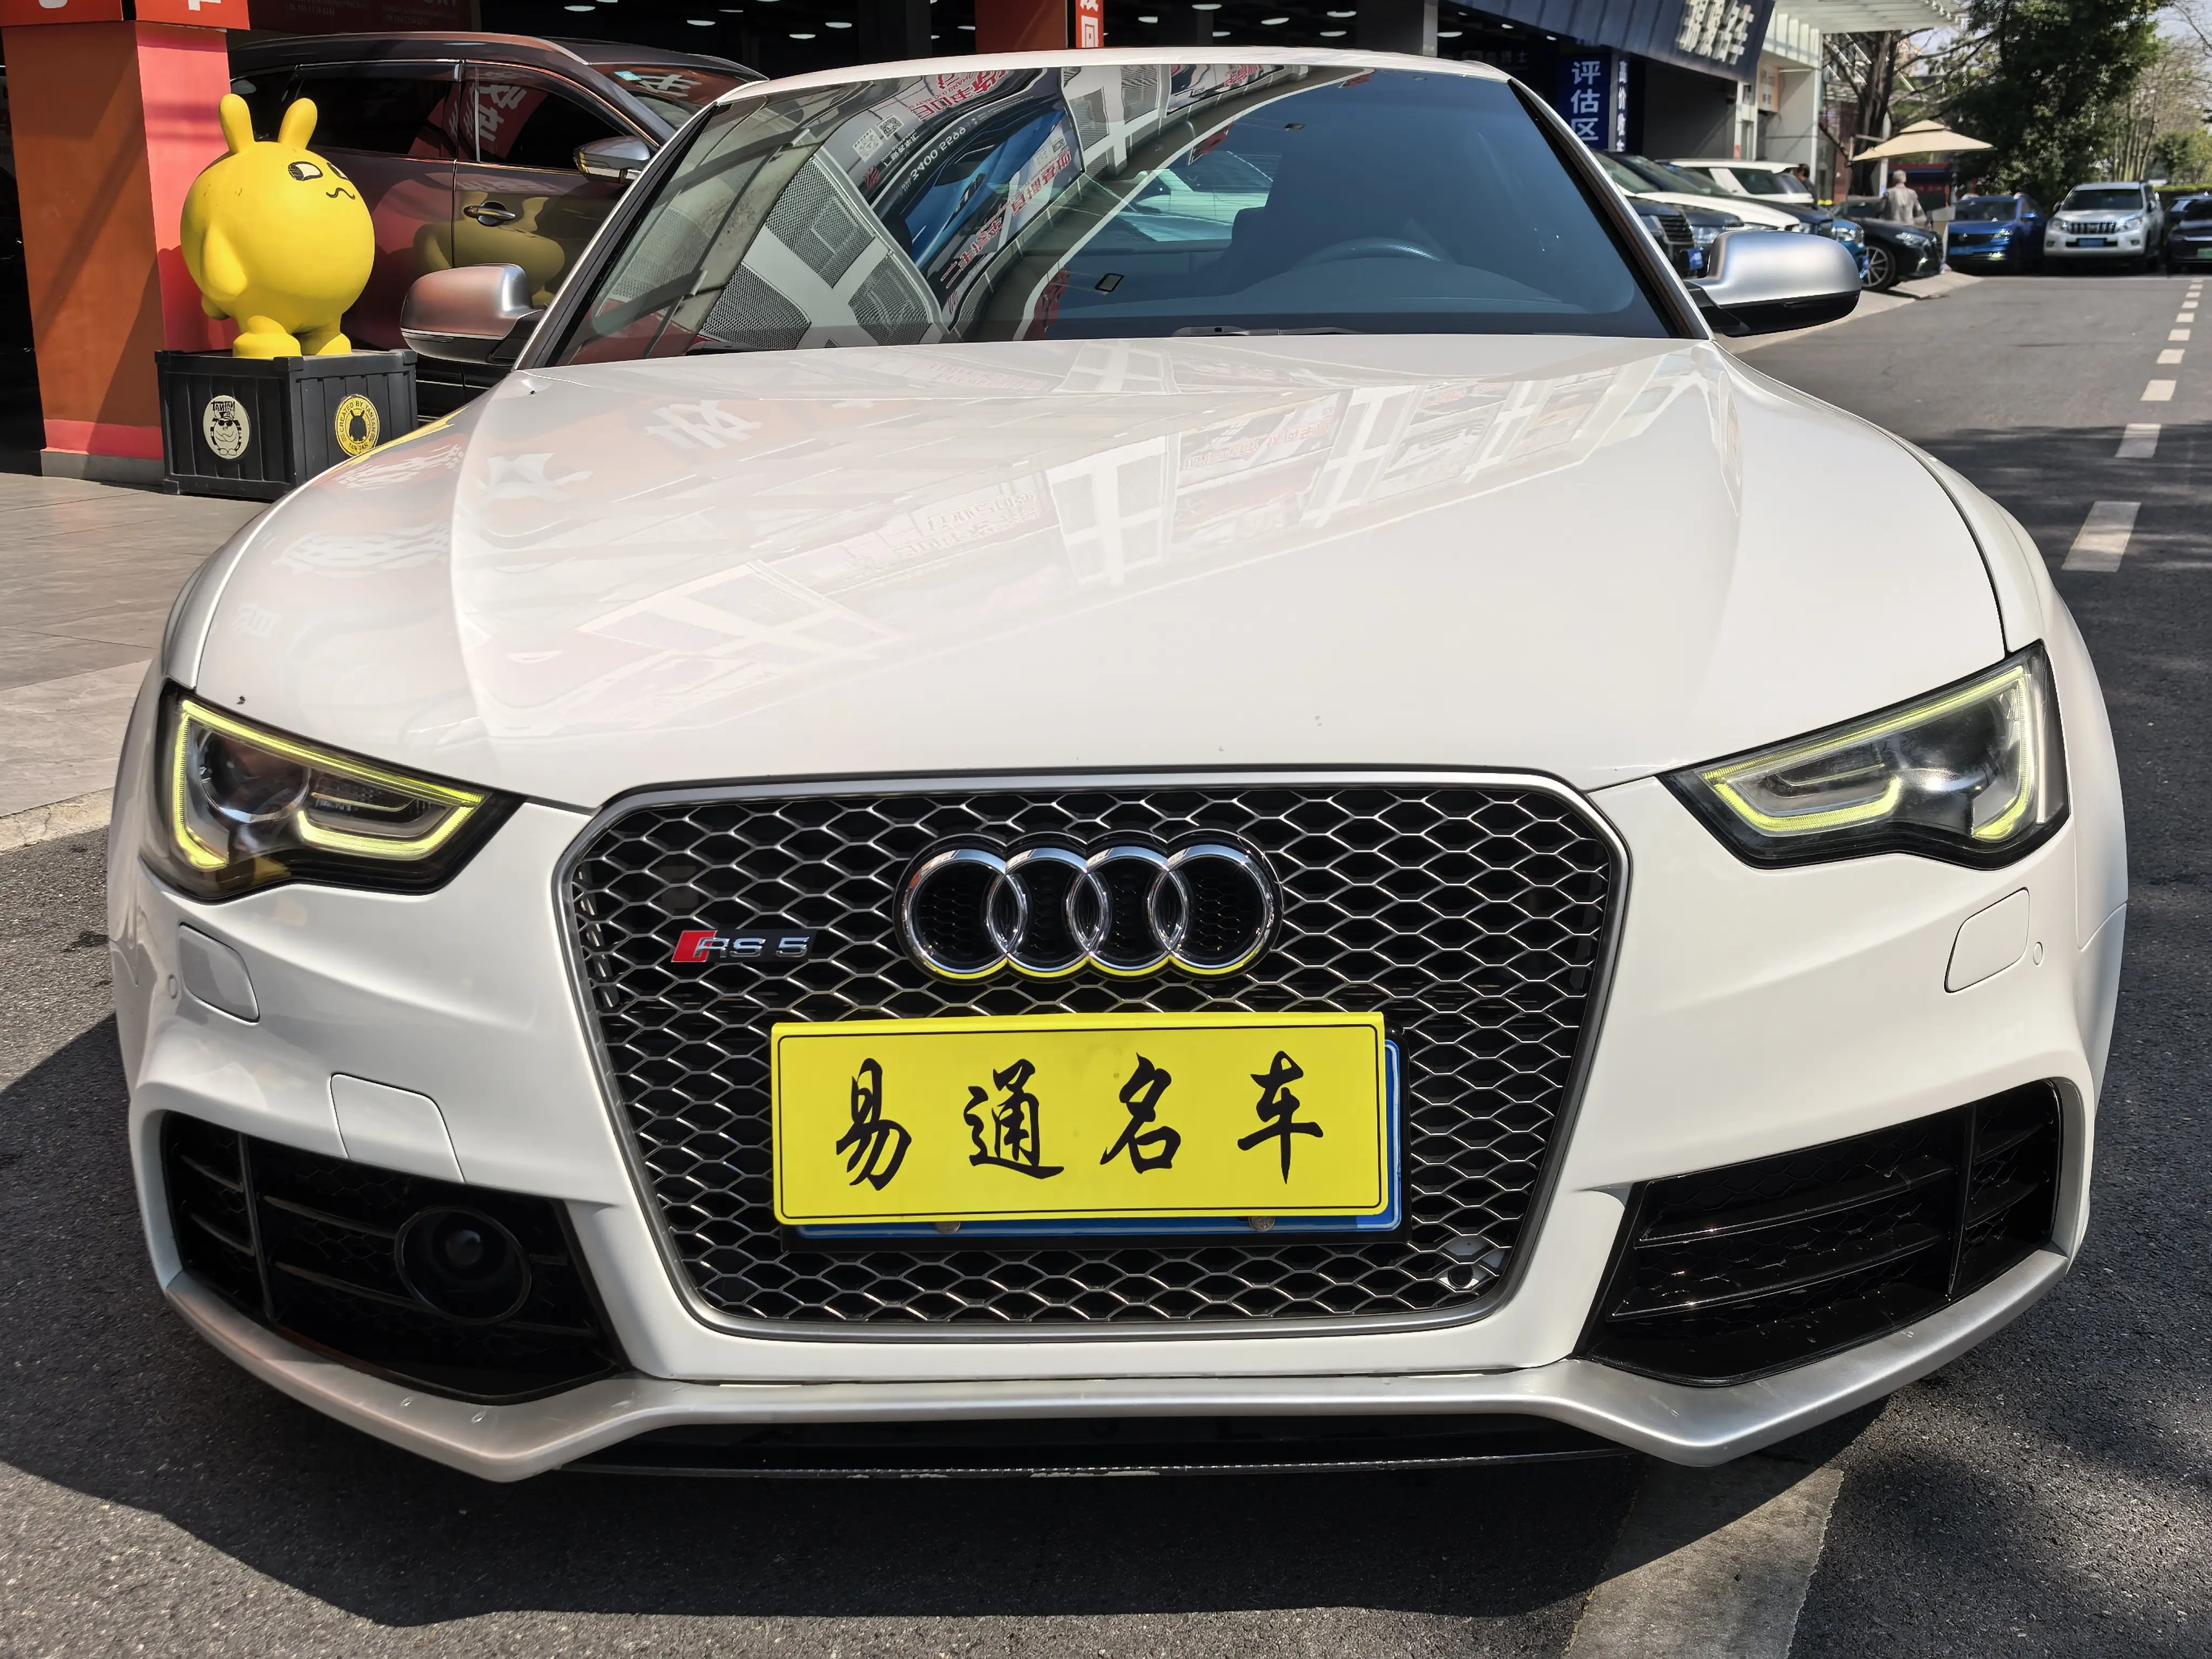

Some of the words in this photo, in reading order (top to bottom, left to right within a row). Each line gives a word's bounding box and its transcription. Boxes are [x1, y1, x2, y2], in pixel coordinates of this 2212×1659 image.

[1570, 60, 1601, 141] 评估区
[836, 1050, 1324, 1191] 易通名车
